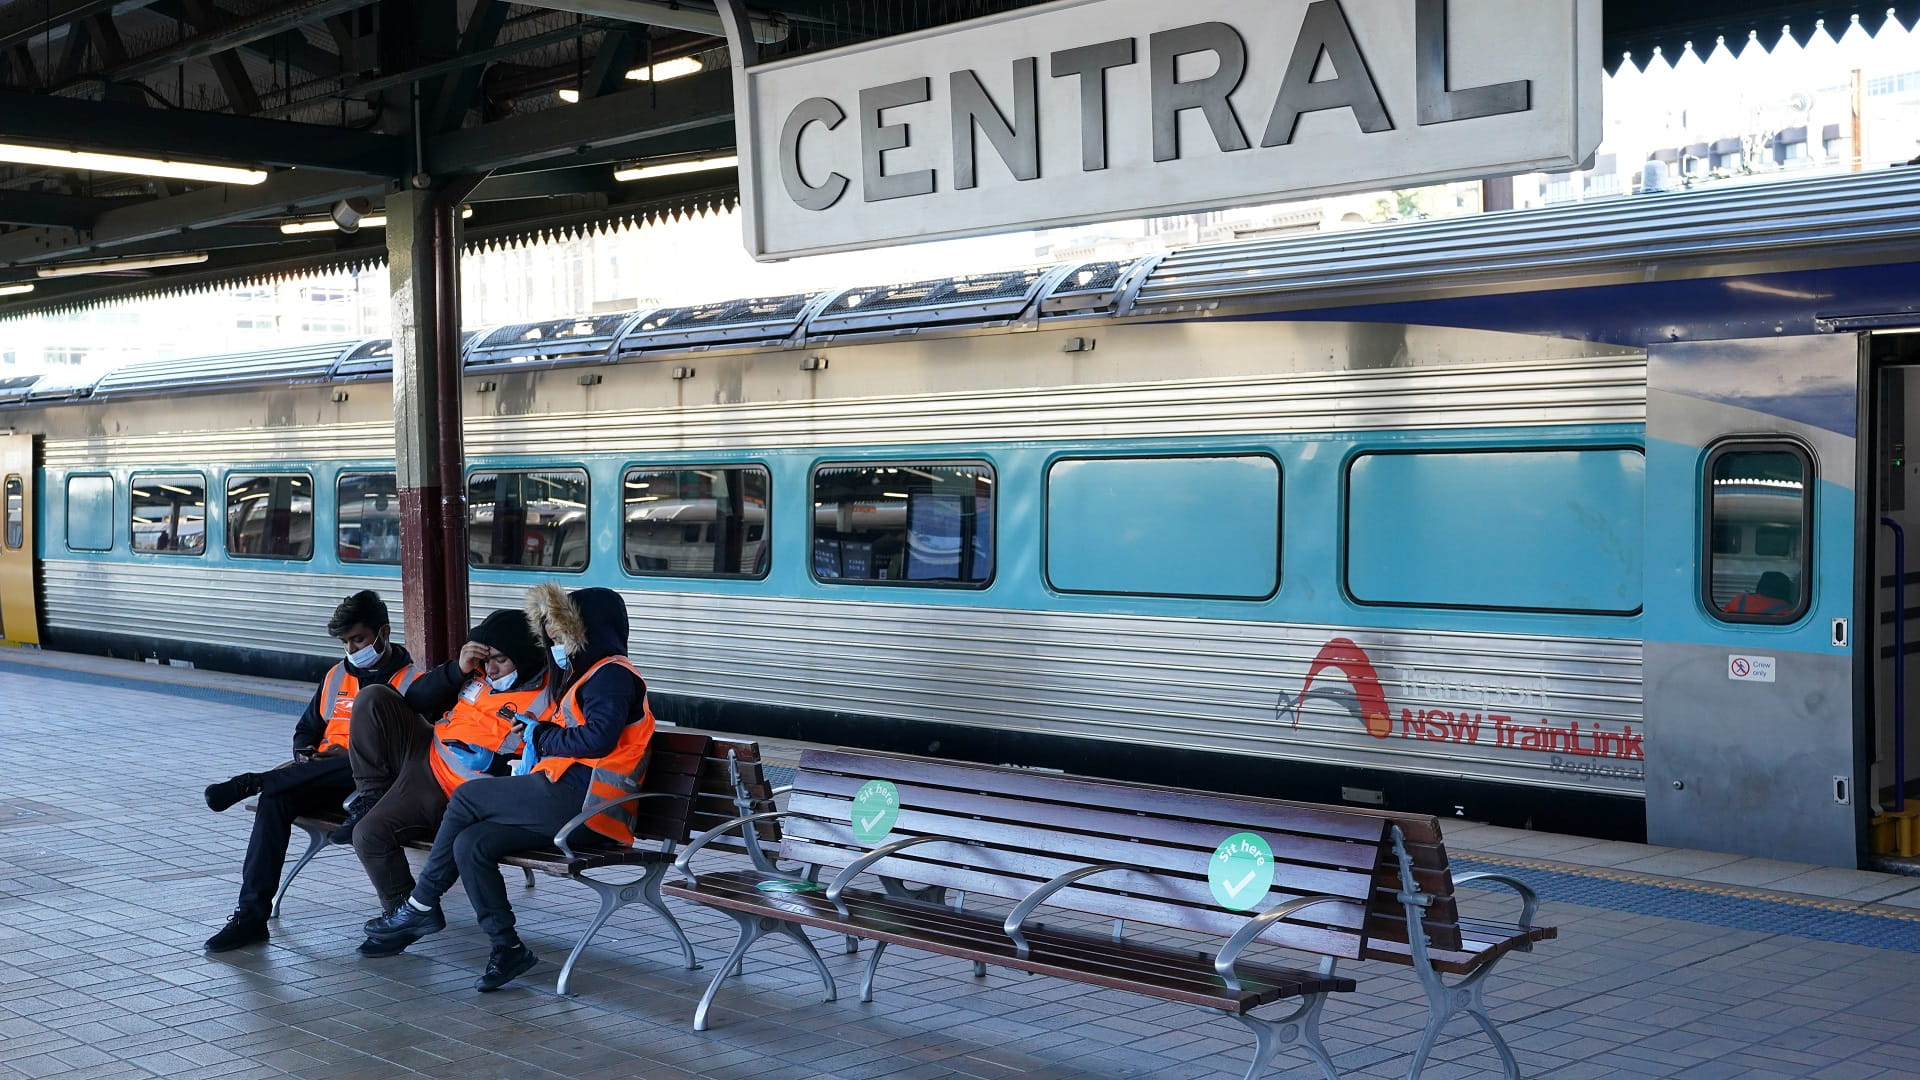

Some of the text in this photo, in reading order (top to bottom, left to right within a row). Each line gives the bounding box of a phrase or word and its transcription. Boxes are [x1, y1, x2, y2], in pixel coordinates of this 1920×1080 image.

[779, 0, 1531, 211] CENTRAL
[1752, 661, 1771, 669] Crew
[1752, 670, 1767, 678] only
[1396, 666, 1551, 711] Transport
[1402, 708, 1644, 760] NSW TrainLink
[859, 783, 893, 806] Sit here
[1219, 839, 1265, 866] Sit here
